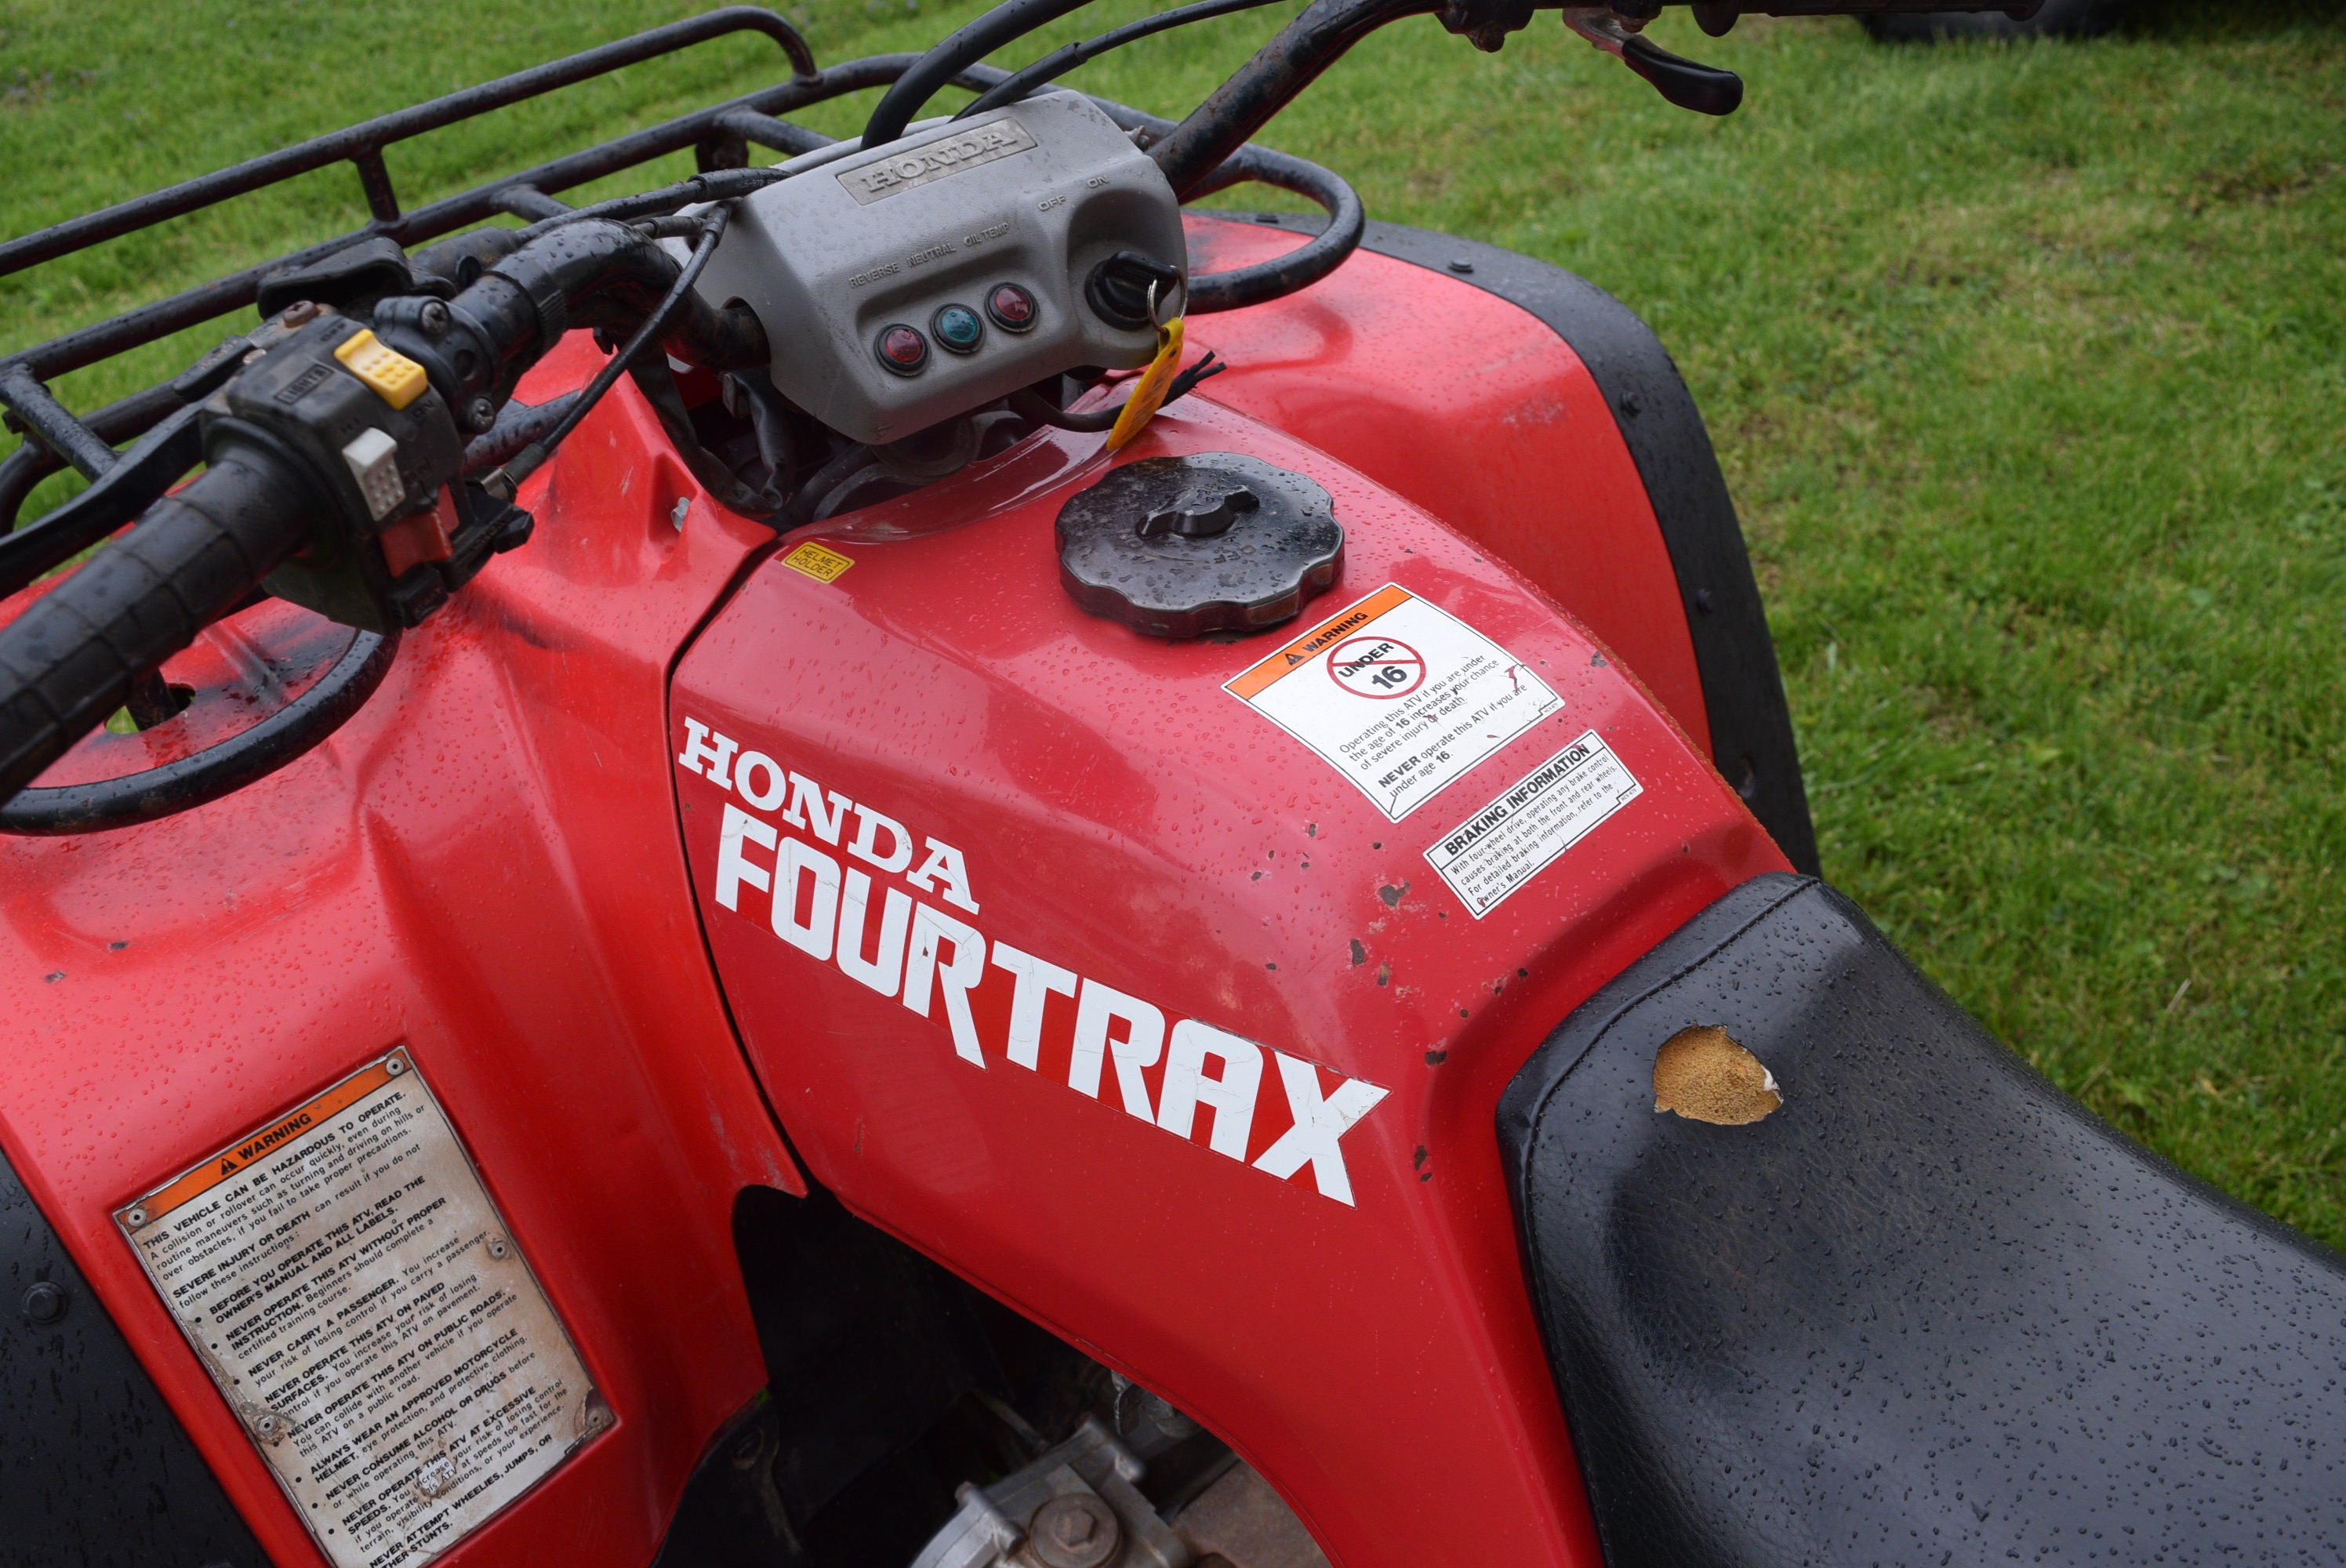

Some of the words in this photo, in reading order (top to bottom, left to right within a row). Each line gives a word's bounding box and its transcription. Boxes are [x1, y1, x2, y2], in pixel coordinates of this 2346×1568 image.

[862, 131, 1018, 193] HONDA
[1038, 195, 1066, 212] OFF
[1088, 175, 1109, 189] ON
[848, 262, 900, 289] REVERSE
[906, 243, 956, 267] NEUTRAL
[964, 234, 982, 247] OIL
[981, 222, 1010, 240] TEMP
[791, 555, 833, 576] HOLDER
[799, 549, 843, 569] HELMET
[1302, 611, 1368, 652] WARNING
[1338, 642, 1395, 679] UNDER
[1370, 666, 1408, 691] 16
[1338, 720, 1390, 753] Operating
[1383, 707, 1405, 722] this
[1402, 694, 1423, 710] ATV
[1429, 681, 1448, 694] you
[1445, 670, 1462, 682] are
[1459, 654, 1485, 672] under
[1348, 747, 1367, 761] the
[1367, 735, 1386, 750] age
[1394, 717, 1411, 729] 16
[1408, 691, 1451, 720] increases
[1449, 678, 1471, 695] your
[1468, 659, 1499, 680] chance
[1370, 739, 1403, 762] severe
[1400, 720, 1429, 742] injury
[1426, 713, 1440, 723] or
[1377, 756, 1422, 787] NEVER
[1418, 732, 1457, 760] operate
[1452, 720, 1473, 735] this
[1469, 707, 1491, 724] ATV
[1496, 694, 1514, 708] you
[1511, 684, 1527, 695] are
[678, 717, 979, 915] HONDA
[1388, 774, 1418, 798] under
[1417, 762, 1437, 778] age
[1444, 804, 1508, 856] BRAKING
[1505, 742, 1590, 809] INFORMATION
[1450, 858, 1469, 875] With
[1468, 830, 1506, 862] four-wheel
[1505, 817, 1527, 835] drive,
[1525, 793, 1558, 820] operating
[1556, 784, 1571, 797] any
[1567, 770, 1588, 786] brake
[1586, 753, 1609, 773] control
[1460, 864, 1486, 885] causes
[1484, 842, 1514, 867] braking
[1520, 822, 1538, 838] both
[1549, 800, 1567, 816] front
[1567, 789, 1581, 804] and
[1580, 781, 1594, 793] rear
[1593, 764, 1617, 782] wheels.
[1467, 882, 1482, 895] For
[1482, 858, 1512, 885] detailed
[1510, 840, 1540, 863] braking
[1537, 810, 1578, 843] information,
[1576, 797, 1593, 812] refer
[1505, 858, 1534, 883] Manual.
[715, 803, 1391, 1207] FOURTRAX
[142, 1229, 169, 1250] THIS
[172, 1200, 220, 1232] VEHICLE
[223, 1183, 249, 1202] CAN
[251, 1171, 268, 1185] BE
[271, 1131, 336, 1174] HAZARDOUS
[338, 1120, 354, 1134] TO
[357, 1090, 405, 1123] OPERATE.
[237, 1112, 311, 1160] WARNING
[172, 1267, 216, 1298] SEVERE
[216, 1243, 256, 1272] INJURY
[258, 1232, 274, 1246] OR
[274, 1210, 310, 1236] DEATH
[314, 1199, 332, 1212] can
[334, 1178, 361, 1200] result
[372, 1163, 390, 1178] you
[405, 1142, 420, 1156] not
[209, 1284, 252, 1315] BEFORE
[252, 1269, 276, 1287] YOU
[277, 1238, 325, 1272] OPERATE
[324, 1222, 350, 1241] THIS
[350, 1207, 374, 1226] ATV,
[373, 1189, 402, 1210] READ
[403, 1174, 425, 1192] THE
[215, 1289, 263, 1323] OWNER'S
[263, 1261, 309, 1293] MANUAL
[310, 1245, 333, 1264] AND
[334, 1232, 354, 1248] ALL
[355, 1205, 398, 1235] LABELS.
[225, 1313, 262, 1341] NEVER
[262, 1283, 310, 1316] OPERATE
[310, 1266, 336, 1286] THIS
[337, 1252, 357, 1270] ATV
[358, 1221, 405, 1255] WITHOUT
[406, 1196, 446, 1225] PROPER
[247, 1349, 284, 1377] NEVER
[286, 1324, 321, 1352] CARRY
[336, 1276, 399, 1319] PASSENGER.
[401, 1261, 420, 1276] You
[422, 1236, 459, 1264] increase
[263, 1376, 300, 1403] NEVER
[301, 1345, 348, 1379] OPERATE
[348, 1328, 373, 1348] THIS
[375, 1314, 394, 1331] ATV
[395, 1303, 412, 1317] ON
[412, 1281, 445, 1306] PAVED
[286, 1411, 323, 1439] NEVER
[323, 1379, 370, 1414] OPERATE
[369, 1363, 394, 1382] THIS
[396, 1348, 416, 1367] ATV
[416, 1338, 433, 1352] ON
[433, 1313, 468, 1341] PUBLIC
[469, 1289, 506, 1316] ROADS.
[309, 1443, 350, 1474] ALWAYS
[350, 1421, 382, 1445] WEAR
[383, 1410, 398, 1424] AN
[400, 1373, 452, 1413] APPROVED
[452, 1327, 518, 1376] MOTORCYCLE
[325, 1472, 361, 1500] NEVER
[361, 1437, 411, 1475] CONSUME
[412, 1406, 458, 1440] ALCOHOL
[458, 1394, 473, 1407] OR
[473, 1370, 507, 1397] DRUGS
[507, 1351, 535, 1373] before
[341, 1498, 376, 1526] NEVER
[377, 1465, 423, 1501] OPERATE
[423, 1447, 446, 1468] THIS
[448, 1434, 467, 1452] ATV
[482, 1385, 536, 1427] EXCESSIVE
[369, 1541, 404, 1568] NEVER
[405, 1507, 450, 1544] ATTEMPT
[451, 1470, 503, 1511] WHEELIES,
[503, 1445, 539, 1474] JUMPS,
[538, 1433, 552, 1446] OR
[409, 1519, 452, 1552] STUNTS.
